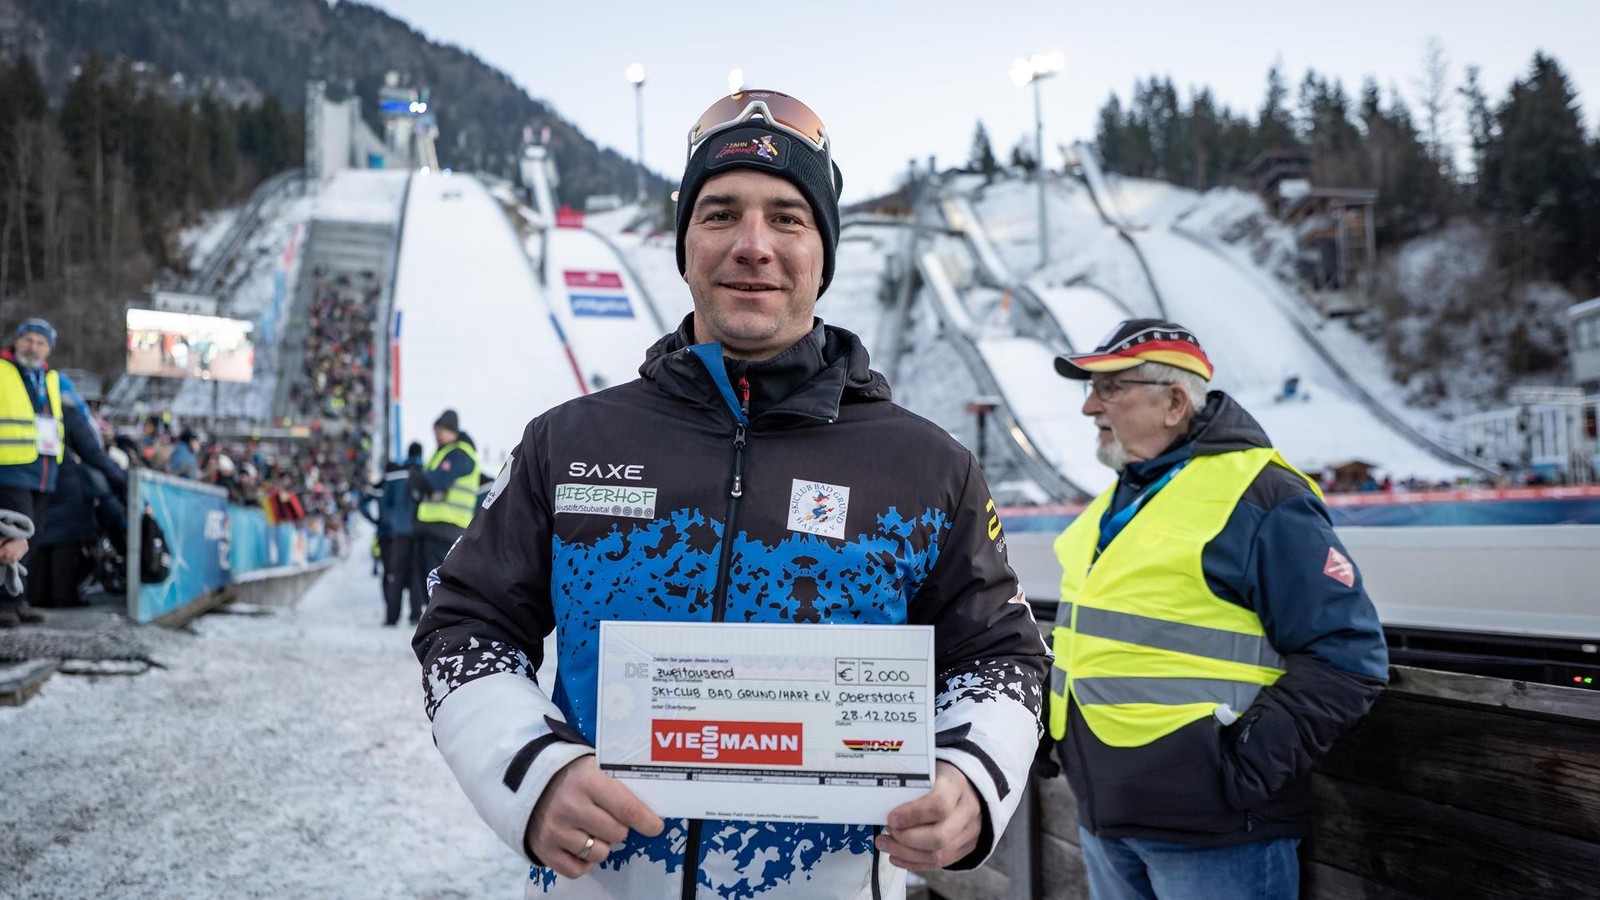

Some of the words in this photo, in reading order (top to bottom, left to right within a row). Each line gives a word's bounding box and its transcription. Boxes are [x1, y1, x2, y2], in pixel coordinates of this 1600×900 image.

[729, 141, 748, 149] ZAHN
[568, 461, 645, 480] SAXE
[556, 485, 656, 505] HIESERHOF
[814, 483, 834, 493] BAD
[833, 491, 847, 524] GRUND
[657, 667, 735, 679] zweitausend
[838, 668, 854, 682] €
[863, 669, 910, 683] 2.000
[651, 686, 701, 699] SKI-CLUB
[707, 688, 733, 700] BAD
[838, 691, 916, 704] Oberstdorf
[841, 710, 917, 723] 28.12.2025
[654, 725, 799, 760] VIESSMANN
